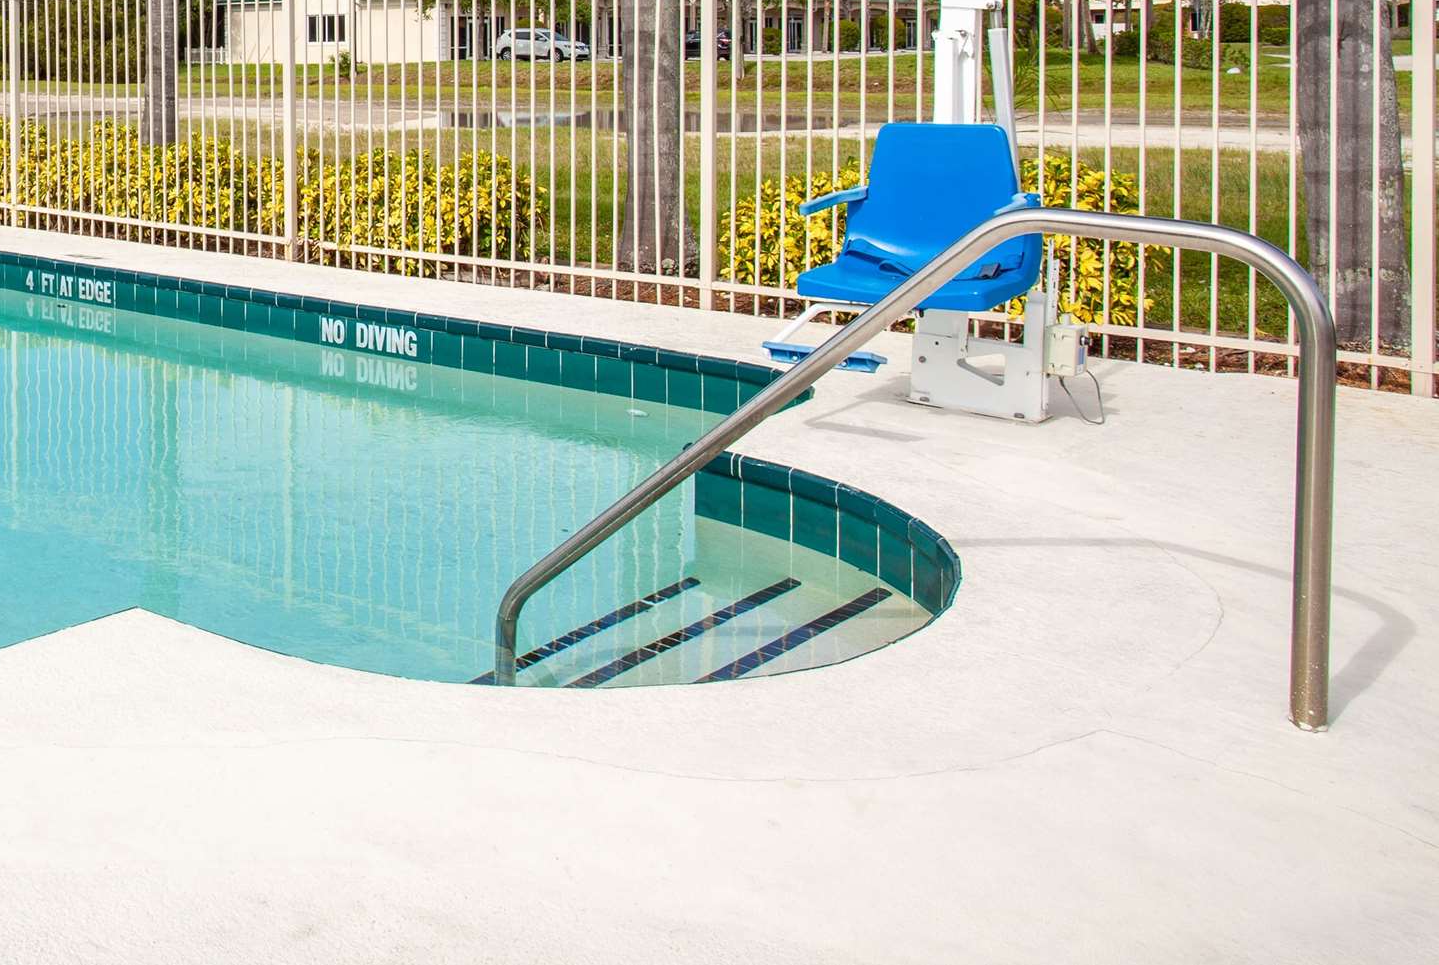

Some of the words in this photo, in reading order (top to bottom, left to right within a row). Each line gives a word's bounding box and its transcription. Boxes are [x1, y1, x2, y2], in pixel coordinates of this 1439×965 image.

[26, 270, 34, 291] 4
[41, 272, 55, 294] FT
[60, 275, 73, 297] AT
[78, 277, 112, 304] EDGE
[321, 317, 344, 344] NO
[355, 322, 417, 357] DIVING
